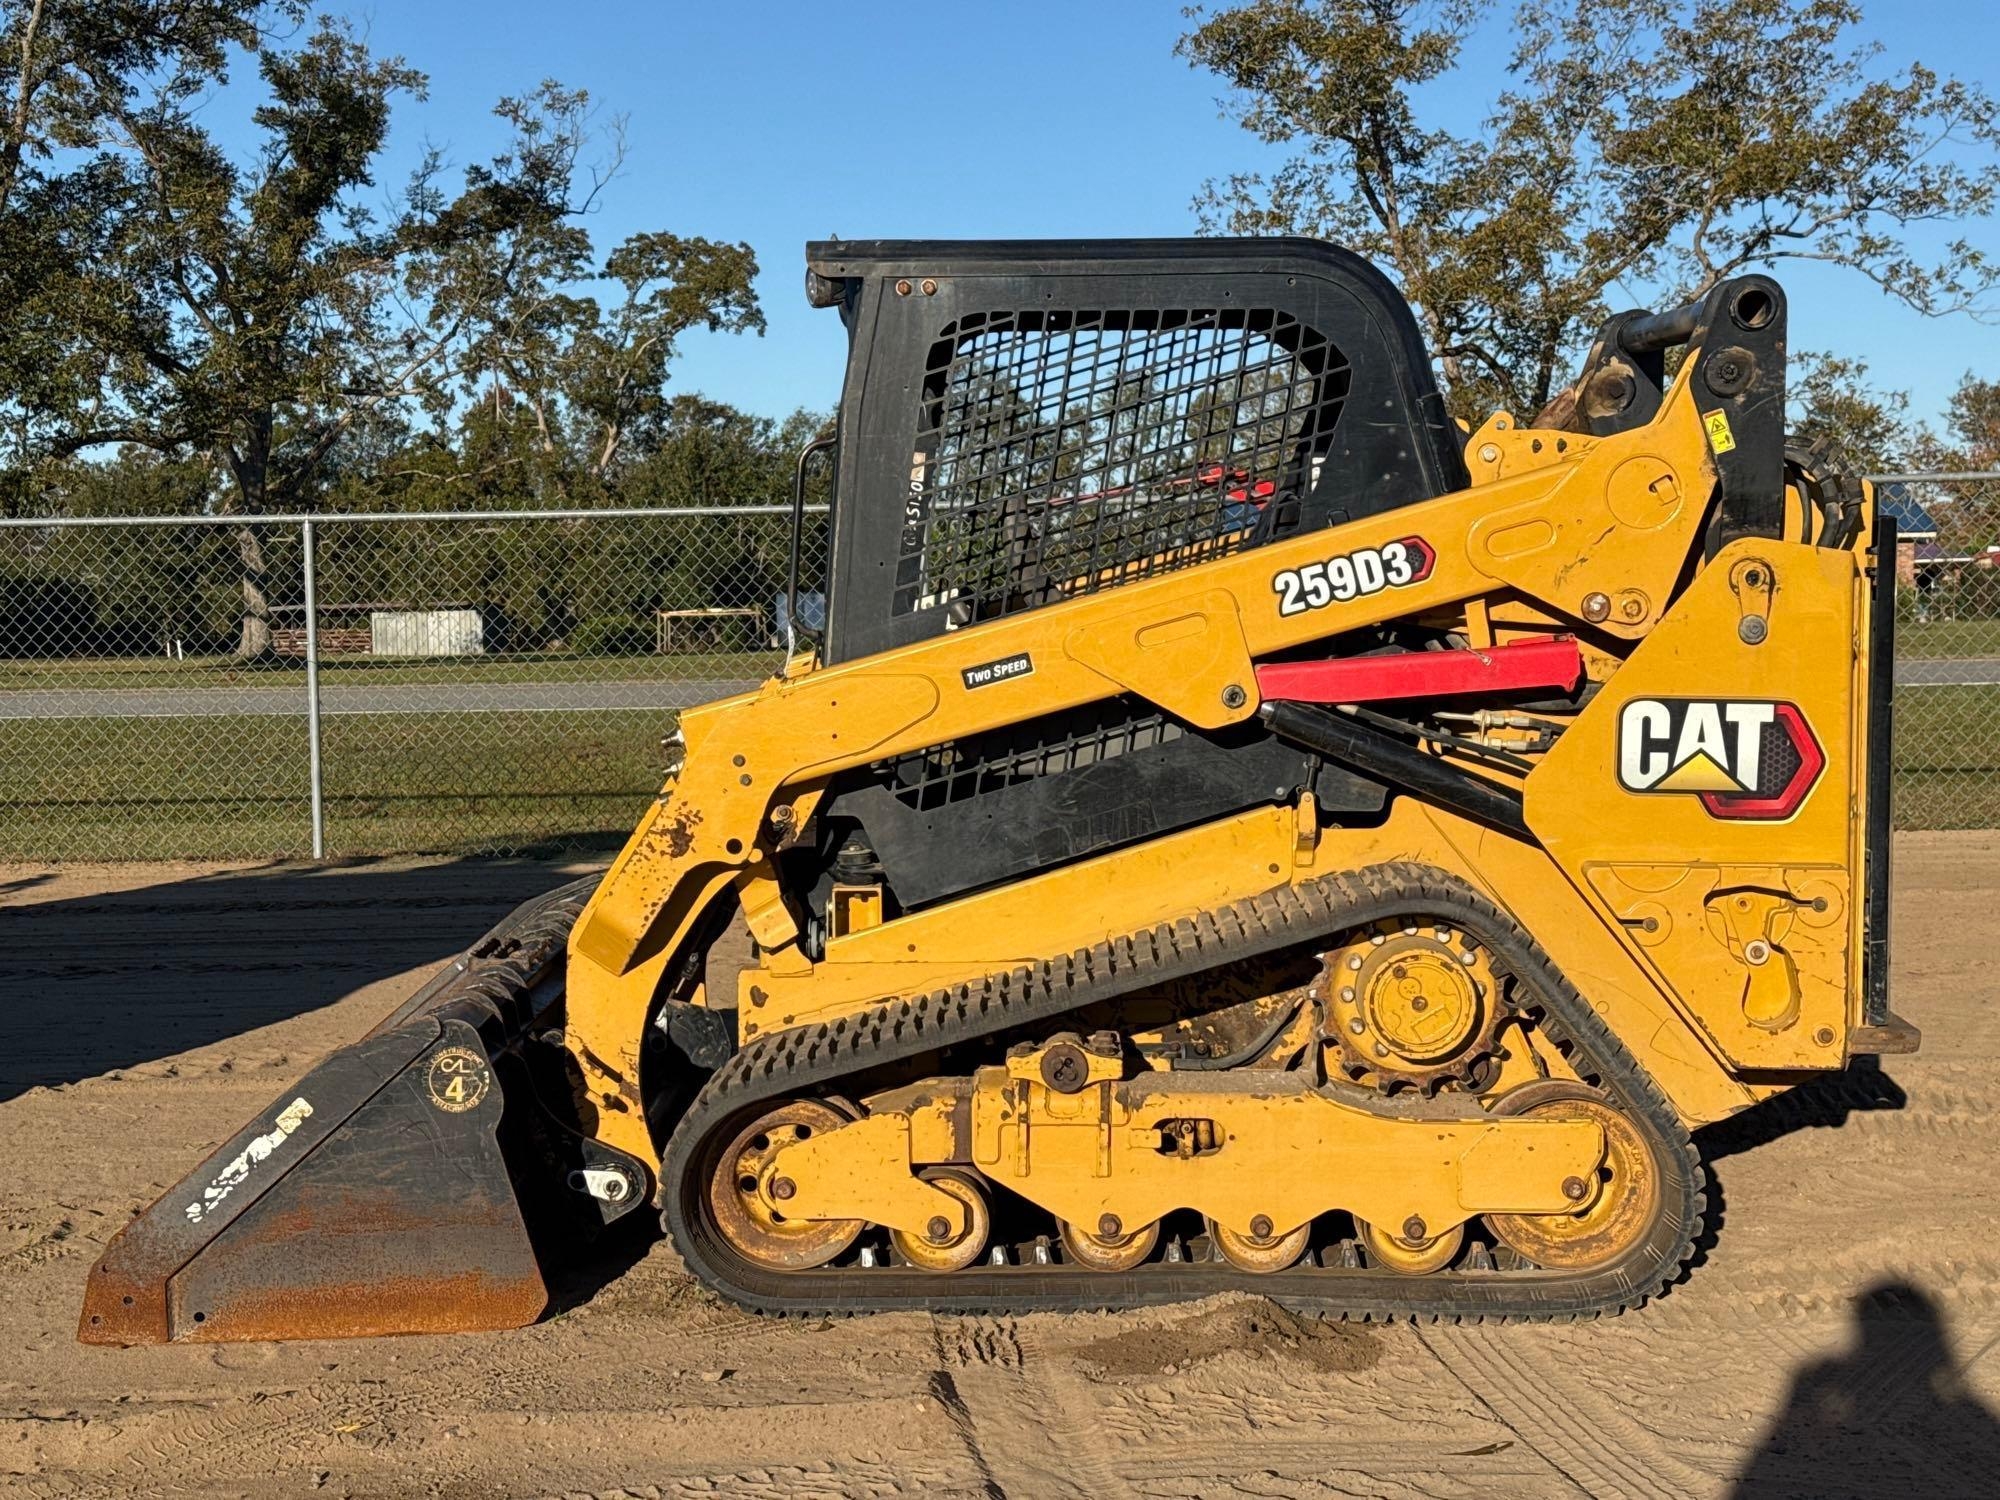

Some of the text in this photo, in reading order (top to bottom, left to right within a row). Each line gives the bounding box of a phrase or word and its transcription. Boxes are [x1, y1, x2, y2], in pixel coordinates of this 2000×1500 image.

[1275, 543, 1412, 615] 259D3
[1621, 700, 1774, 792] CAT
[446, 1076, 464, 1102] 4
